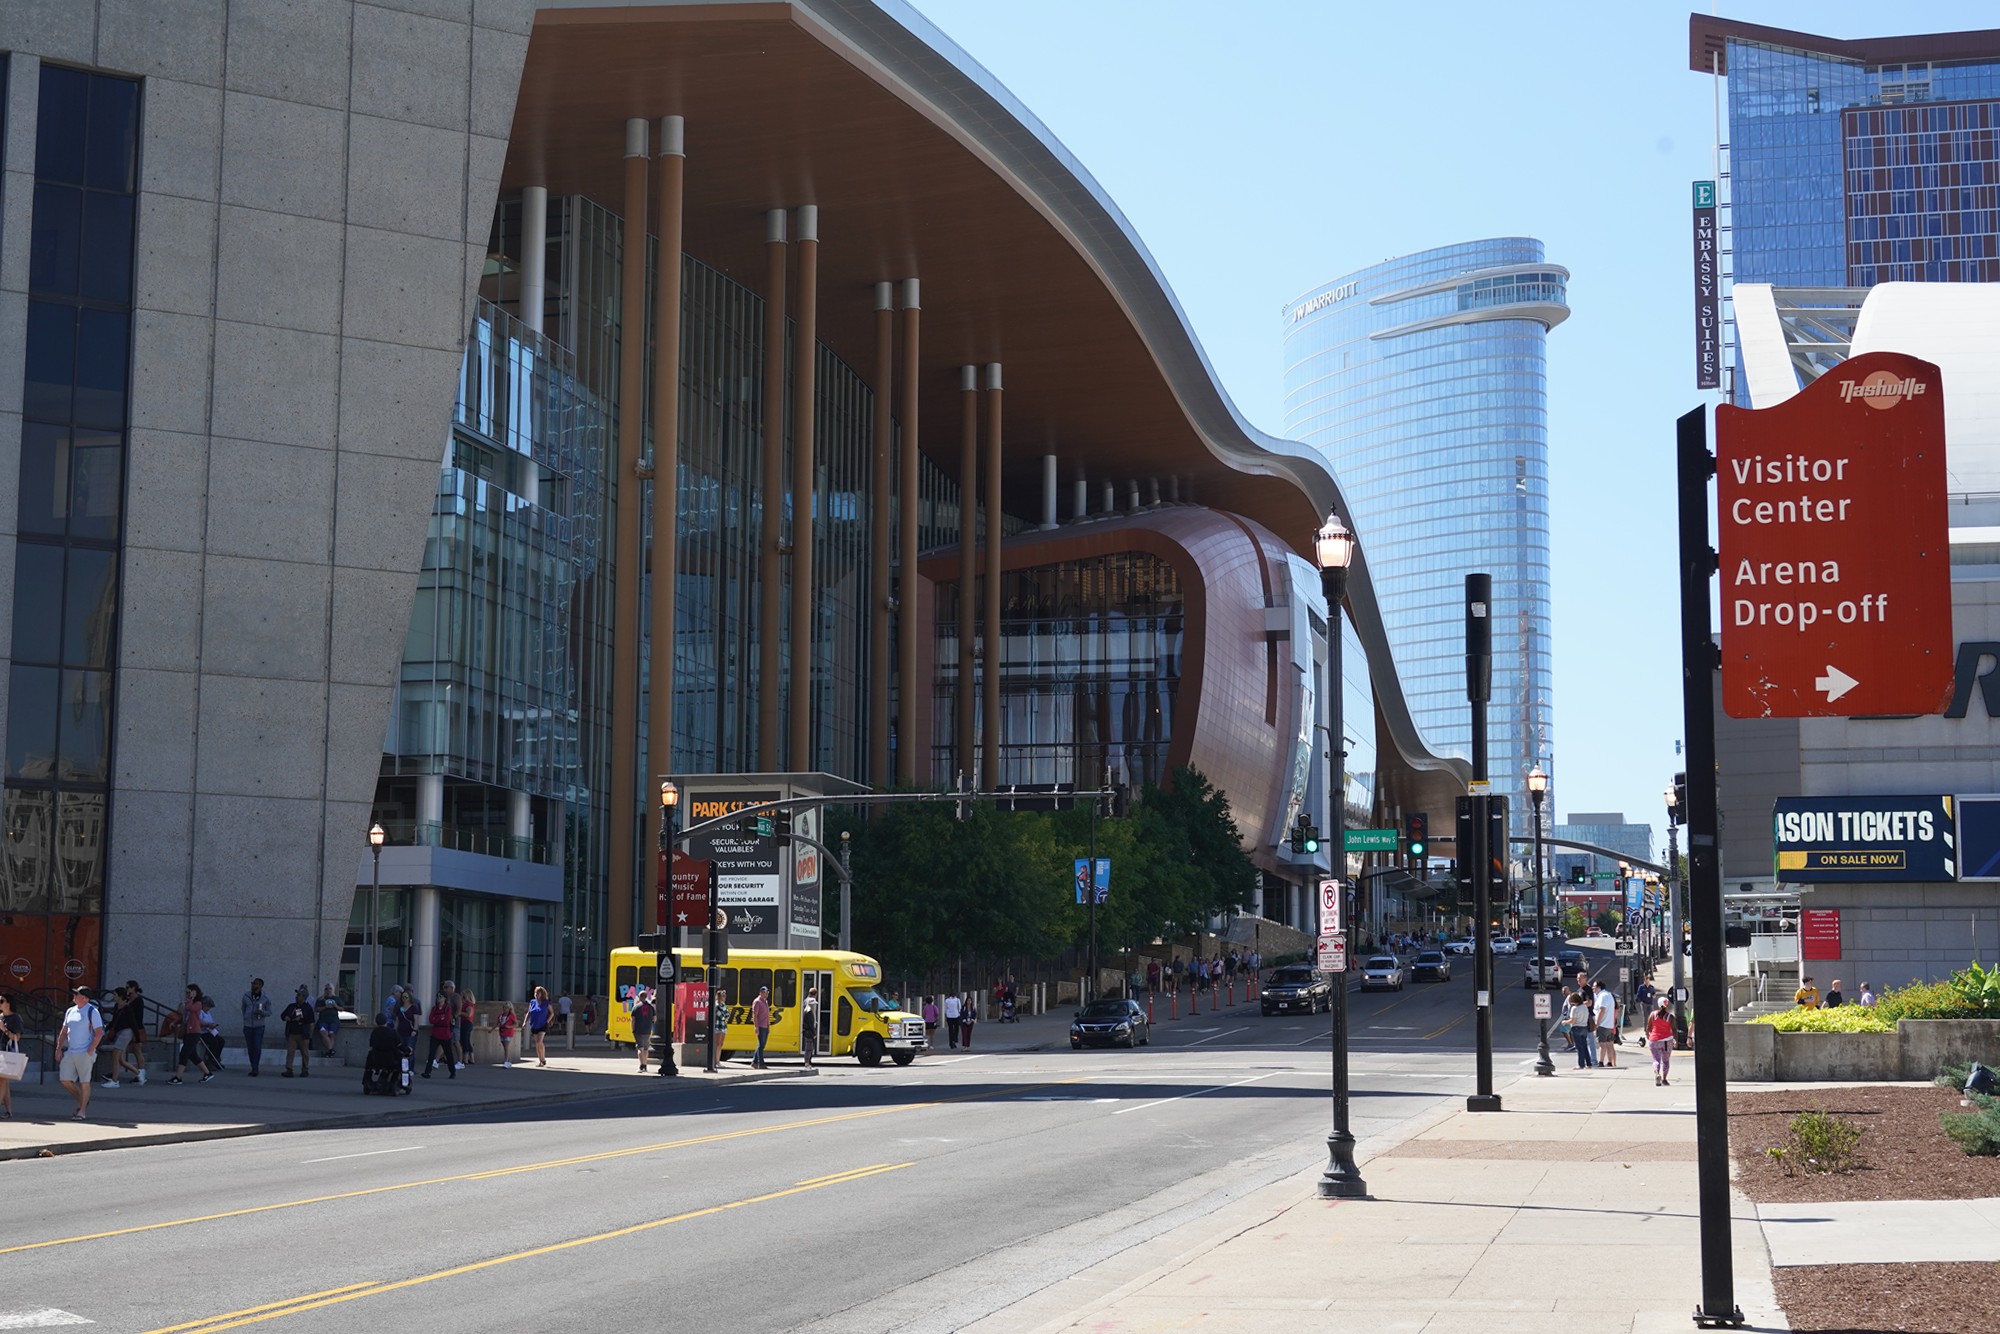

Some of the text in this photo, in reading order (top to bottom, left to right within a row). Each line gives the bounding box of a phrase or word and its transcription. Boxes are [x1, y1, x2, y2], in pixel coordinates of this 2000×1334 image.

[1305, 281, 1359, 316] MARRIOTT
[1697, 217, 1715, 374] EMBASSY SUITES
[1839, 378, 1926, 403] Nashville
[1731, 454, 1849, 484] Visitor
[1732, 496, 1851, 525] Center
[1734, 558, 1840, 586] Arena
[1734, 594, 1888, 632] Drop-off
[692, 802, 728, 817] PARK
[1838, 811, 1934, 842] TICKETS
[715, 846, 754, 854] VALUABLES
[1347, 835, 1362, 844] John
[1363, 835, 1380, 844] Lewis
[798, 856, 816, 881] OPEN
[1820, 855, 1899, 865] ON SALE NOW
[671, 882, 695, 891] Music
[672, 873, 699, 882] ountry
[687, 893, 706, 901] Fame
[693, 1001, 709, 1009] MAP
